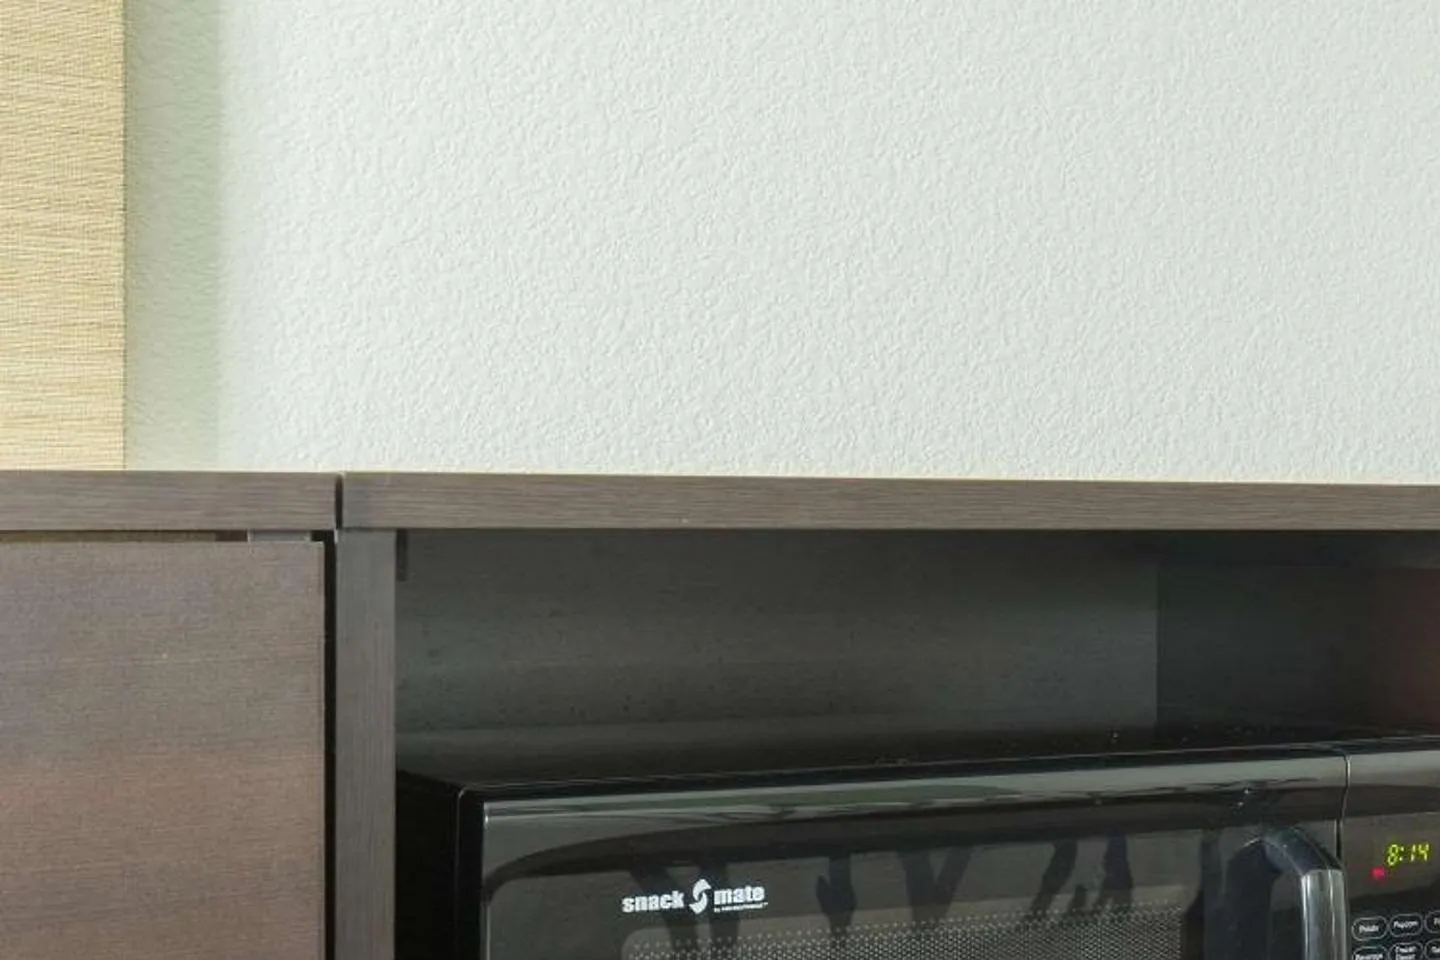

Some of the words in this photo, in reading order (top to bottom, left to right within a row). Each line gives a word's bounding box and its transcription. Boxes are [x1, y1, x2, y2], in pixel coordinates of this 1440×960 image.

[1387, 842, 1430, 866] 8:14
[622, 890, 684, 913] snack
[714, 885, 765, 905] mate
